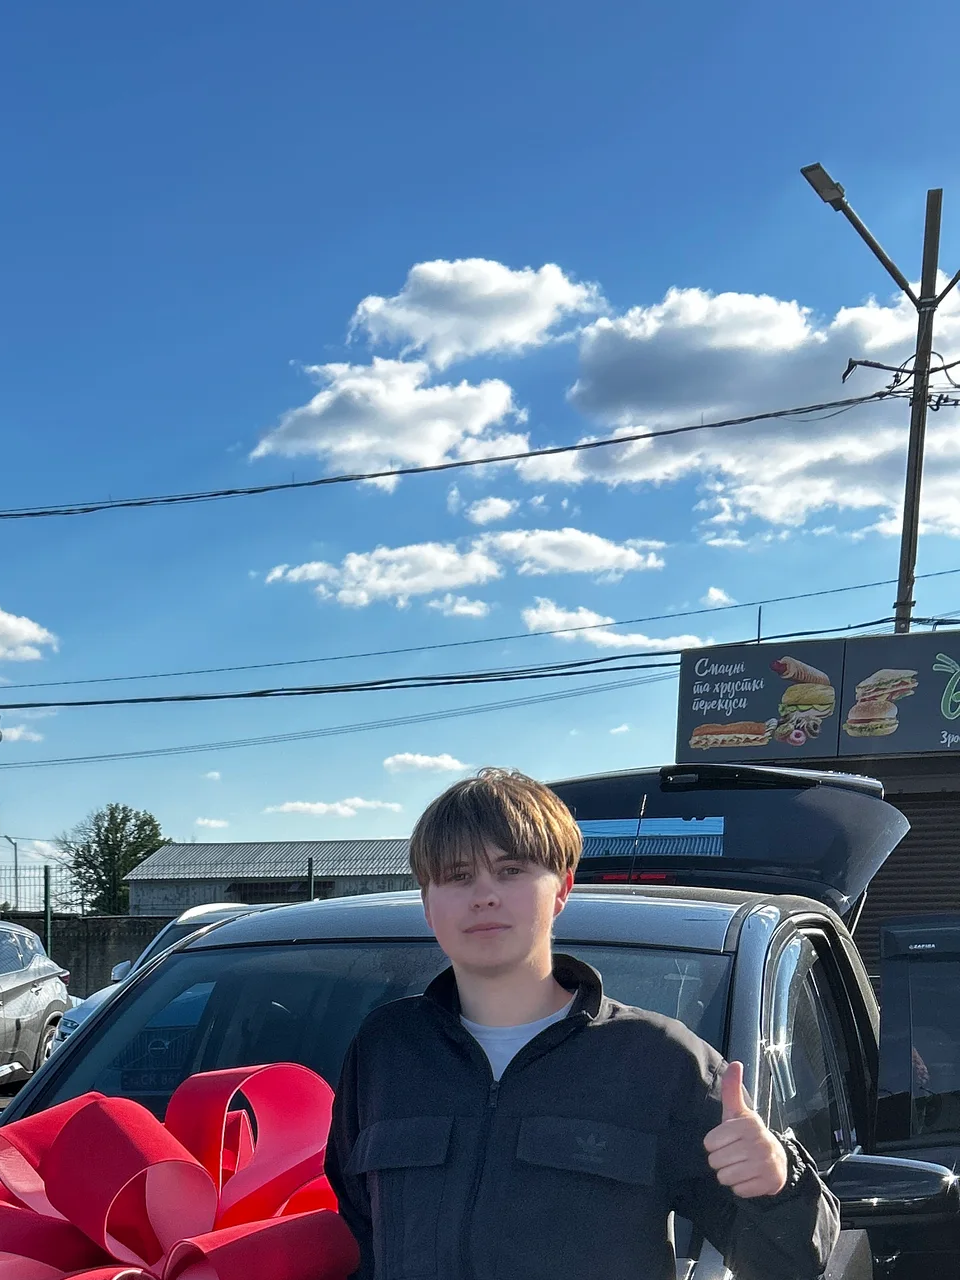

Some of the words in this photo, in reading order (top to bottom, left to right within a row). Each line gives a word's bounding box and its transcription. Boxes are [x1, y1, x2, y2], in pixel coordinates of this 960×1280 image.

[694, 657, 746, 677] Смачні
[692, 681, 711, 695] та
[712, 678, 765, 699] хрусткі
[692, 697, 748, 717] перекуси
